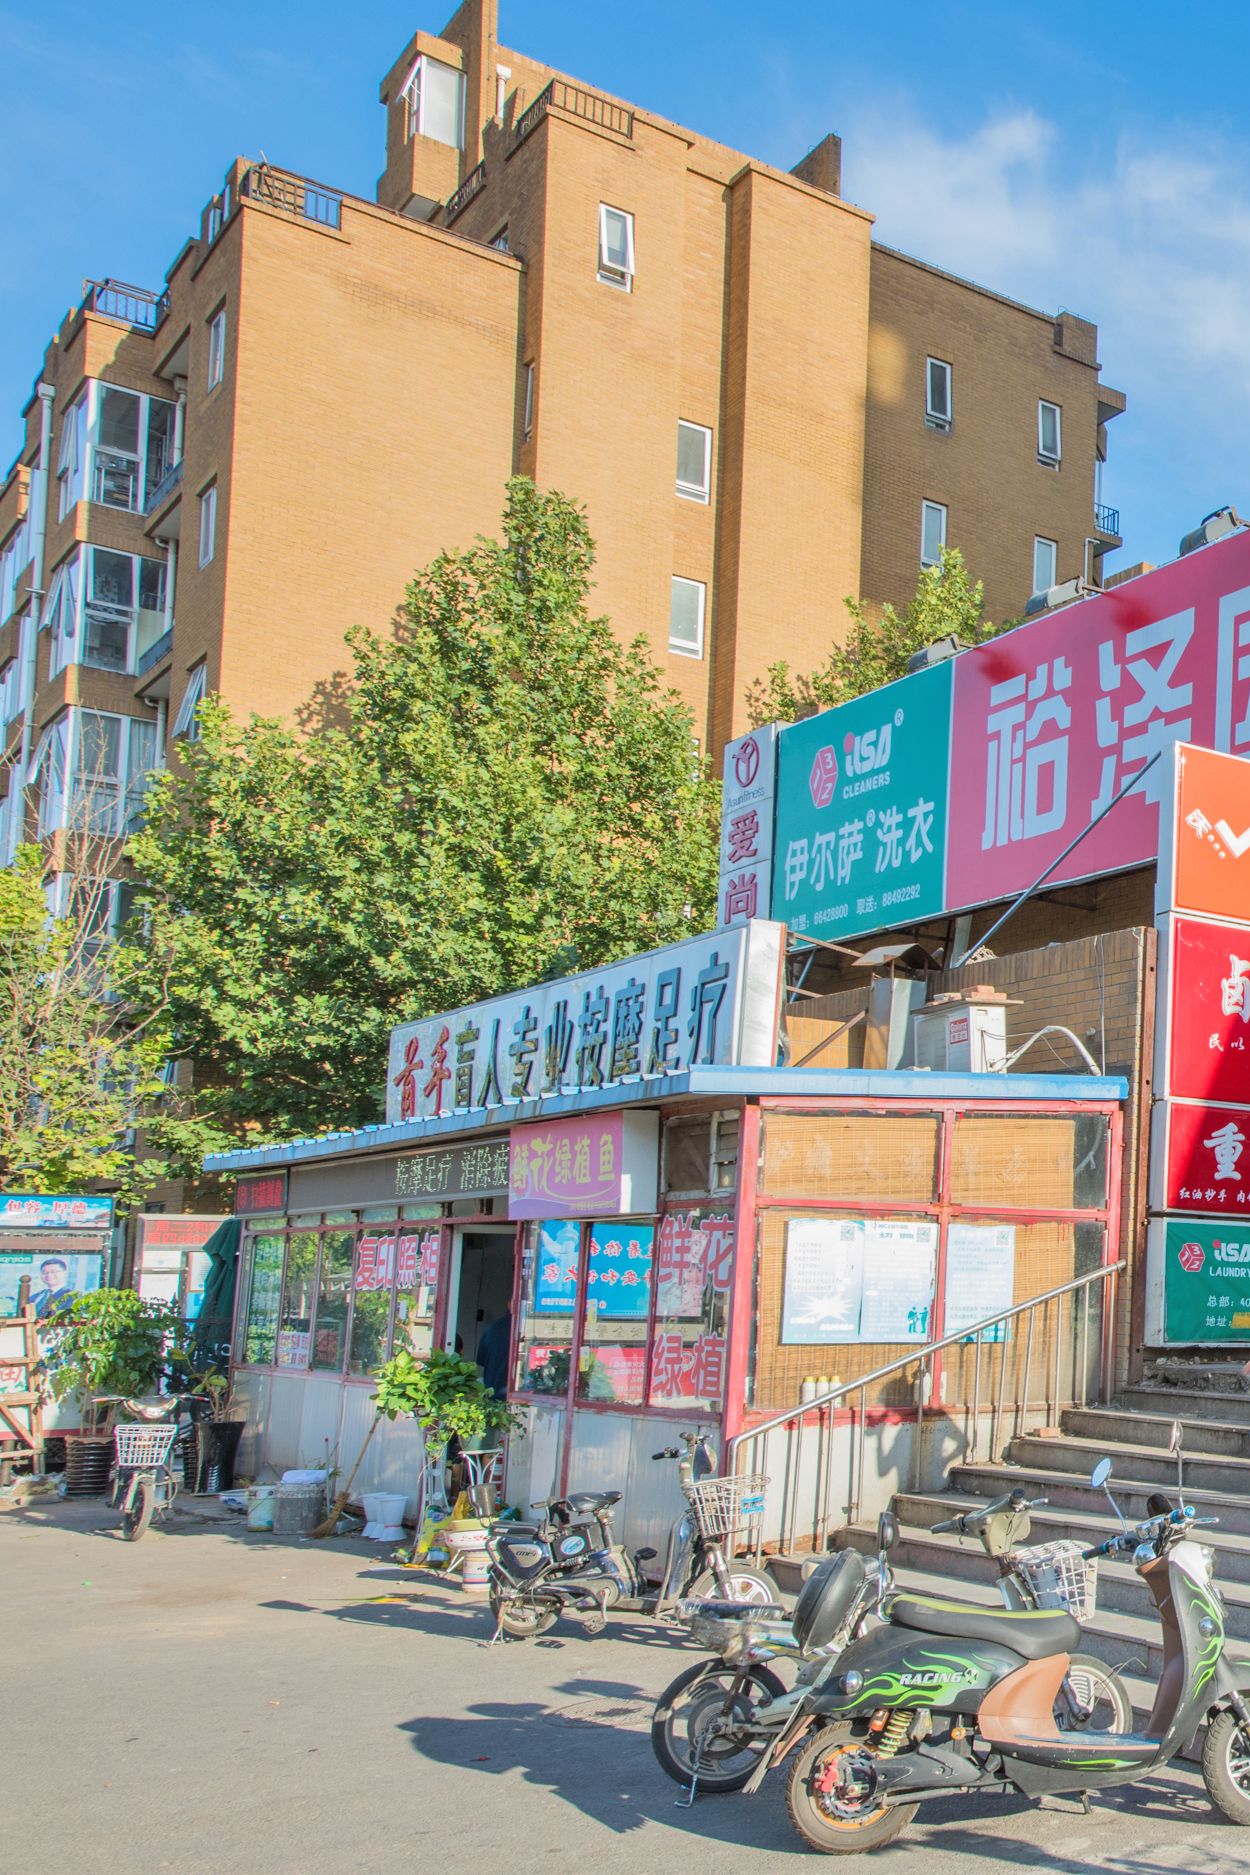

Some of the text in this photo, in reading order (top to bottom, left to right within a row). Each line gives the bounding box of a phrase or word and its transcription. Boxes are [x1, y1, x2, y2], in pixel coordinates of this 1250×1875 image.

[842, 771, 891, 799] CLEANERS
[725, 810, 759, 925] 爱尚
[356, 1232, 440, 1291] 复印照相
[658, 1214, 737, 1290] 鲜花
[652, 1332, 726, 1400] 绿植
[900, 1671, 964, 1686] RACING
